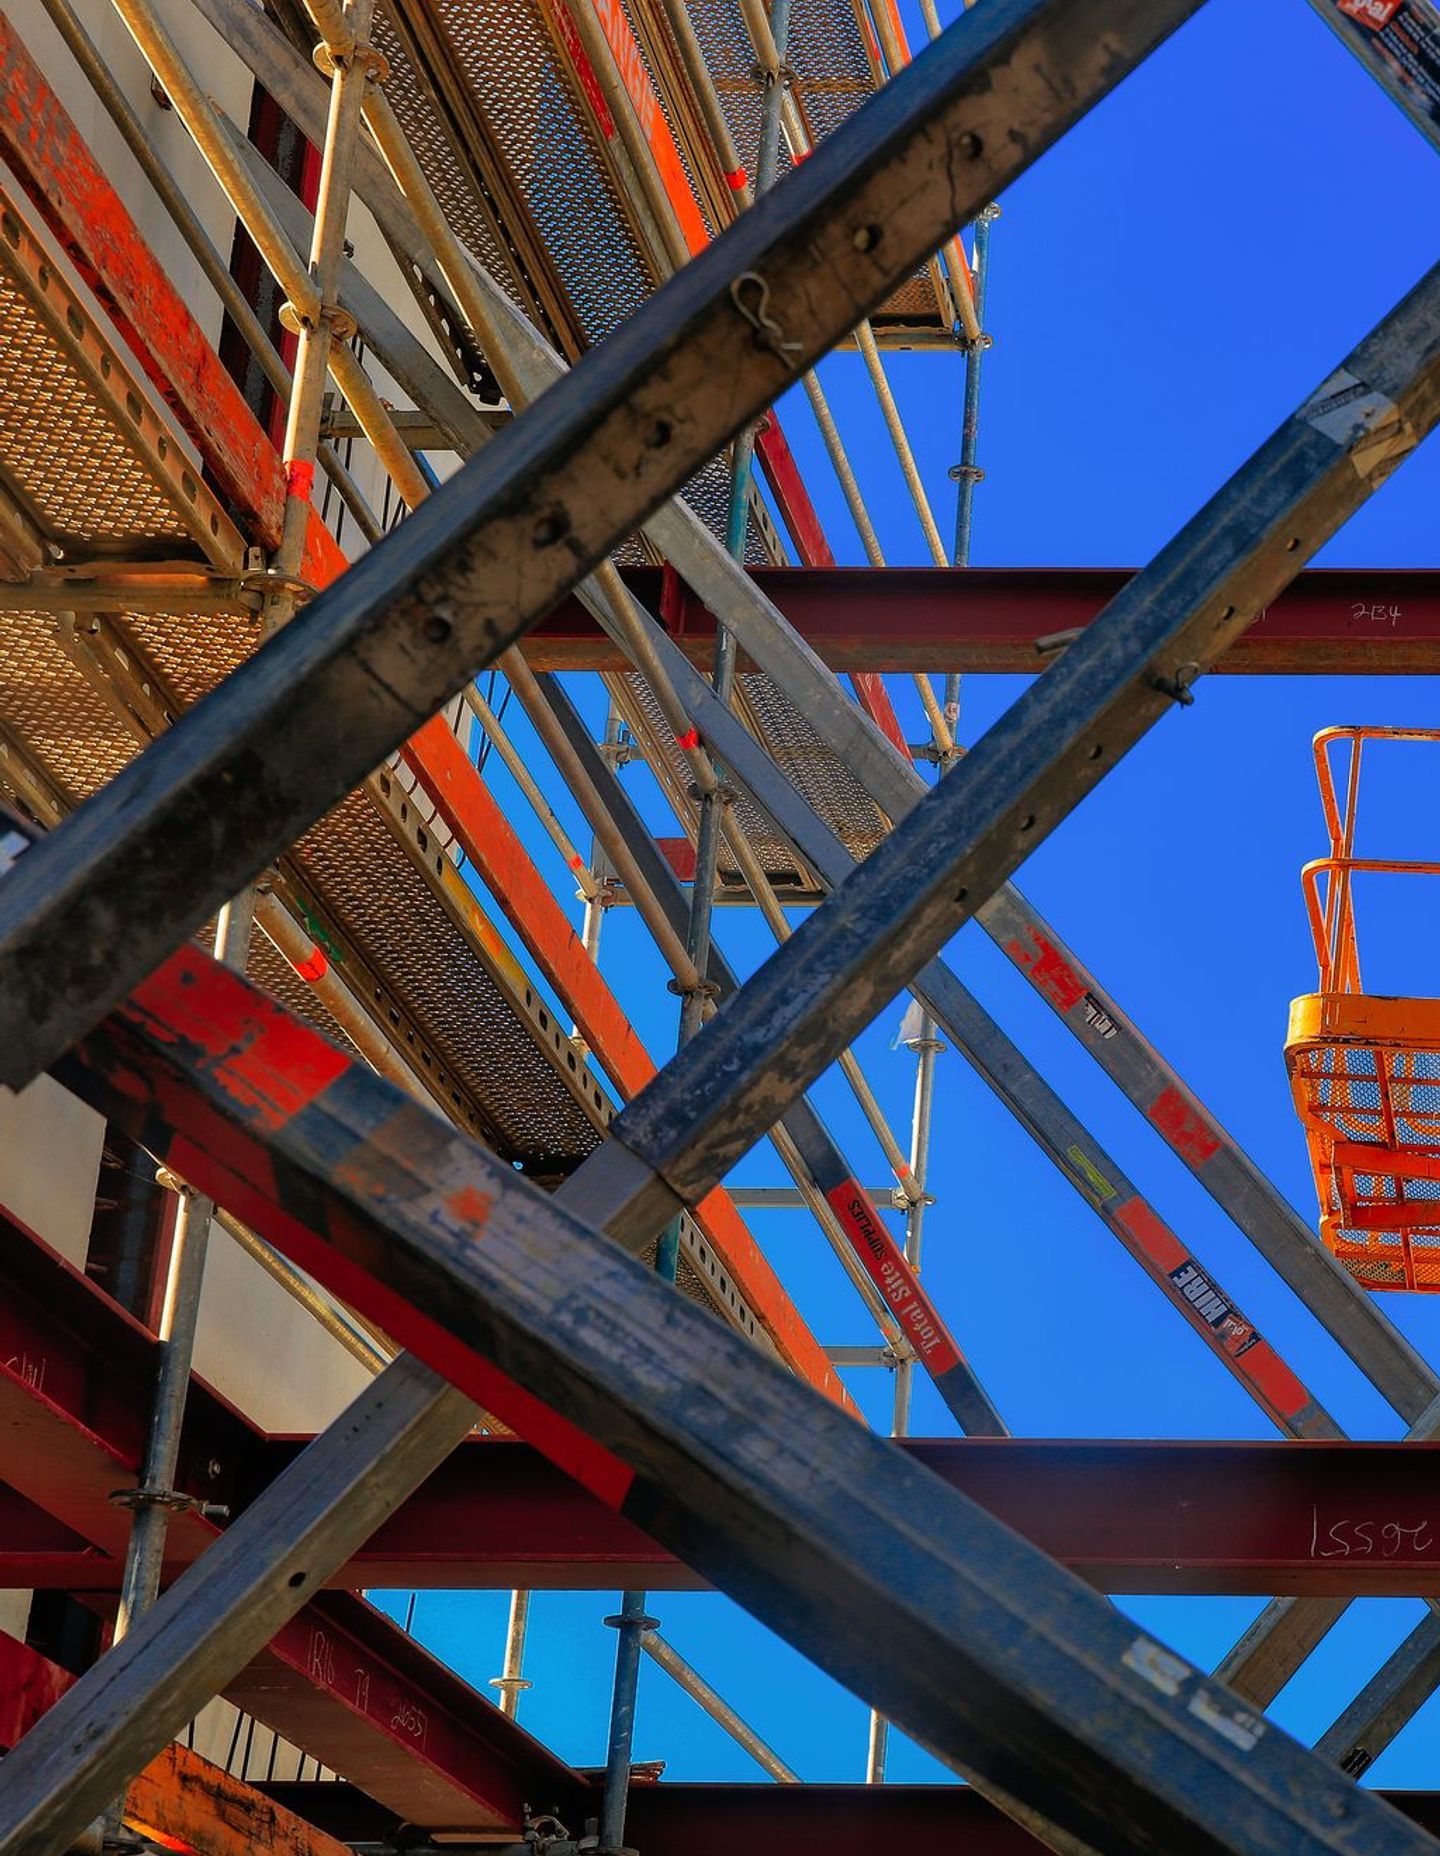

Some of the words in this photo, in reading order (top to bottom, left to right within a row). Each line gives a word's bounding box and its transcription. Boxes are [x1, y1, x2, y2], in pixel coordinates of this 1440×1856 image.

[1350, 602, 1402, 627] 2B4
[846, 1199, 890, 1261] SUPPLIES
[875, 1259, 912, 1303] Site
[1172, 1264, 1228, 1324] HIRE
[900, 1301, 942, 1354] Total
[1310, 1503, 1434, 1558] 26551
